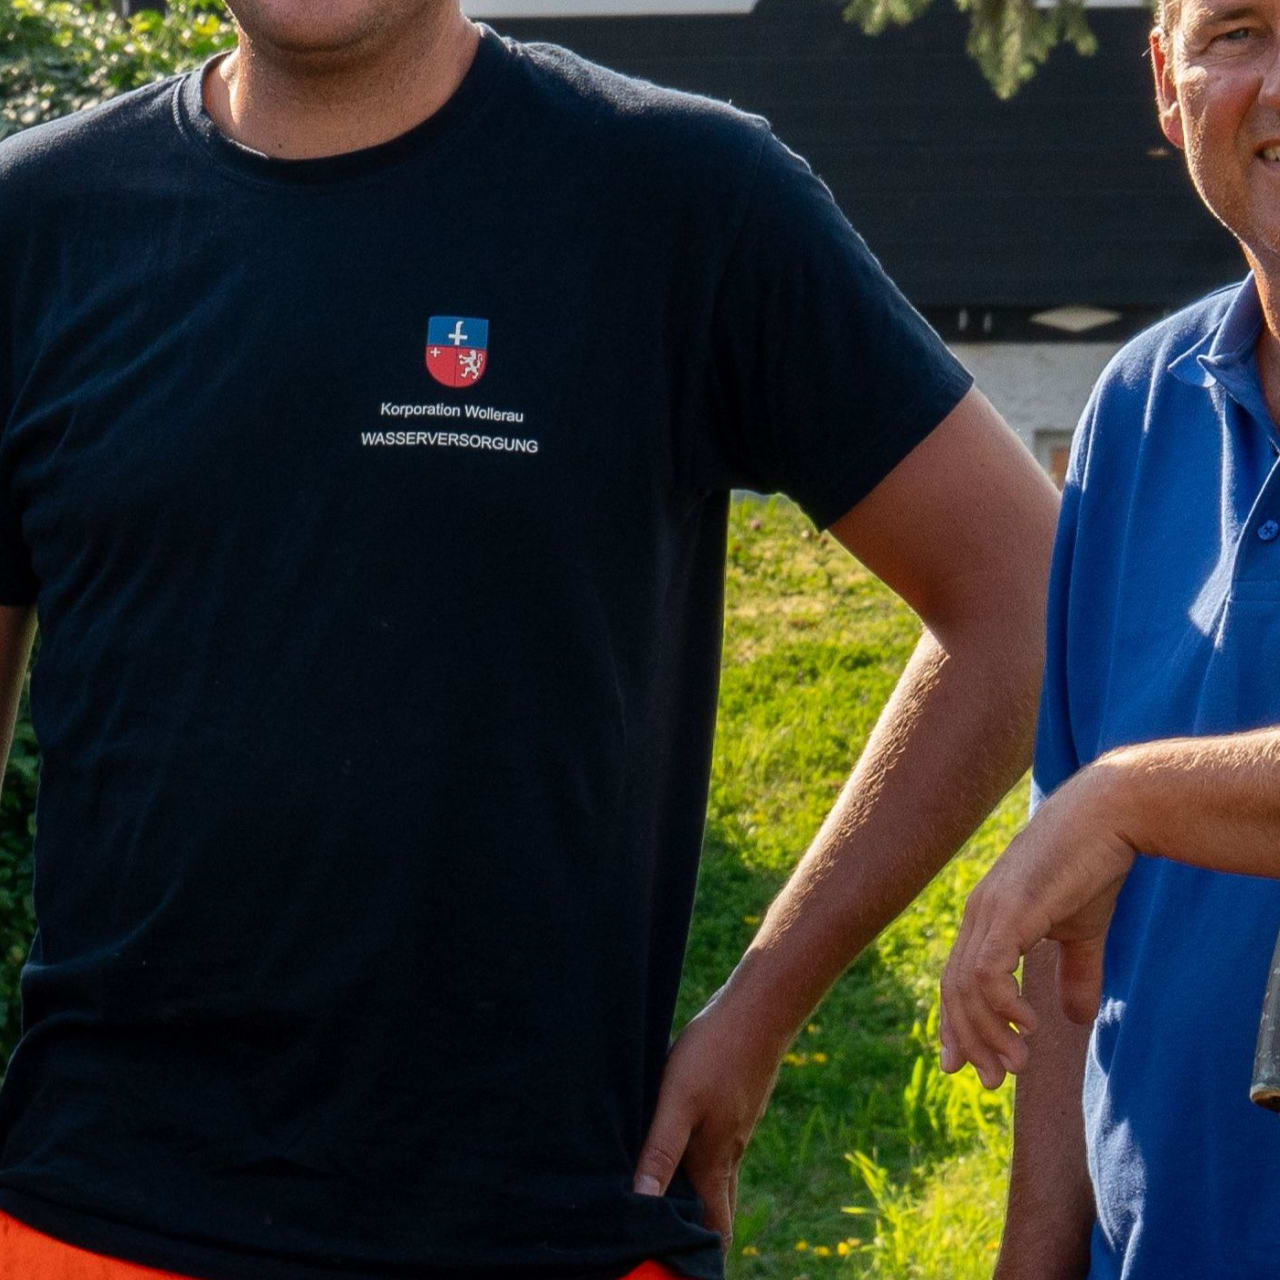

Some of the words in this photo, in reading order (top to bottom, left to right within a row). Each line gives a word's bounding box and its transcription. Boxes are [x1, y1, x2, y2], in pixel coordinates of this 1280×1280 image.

[381, 402, 460, 418] Korporation
[465, 405, 523, 422] Wollerau
[361, 432, 538, 453] WASSERVERSORGUNG
